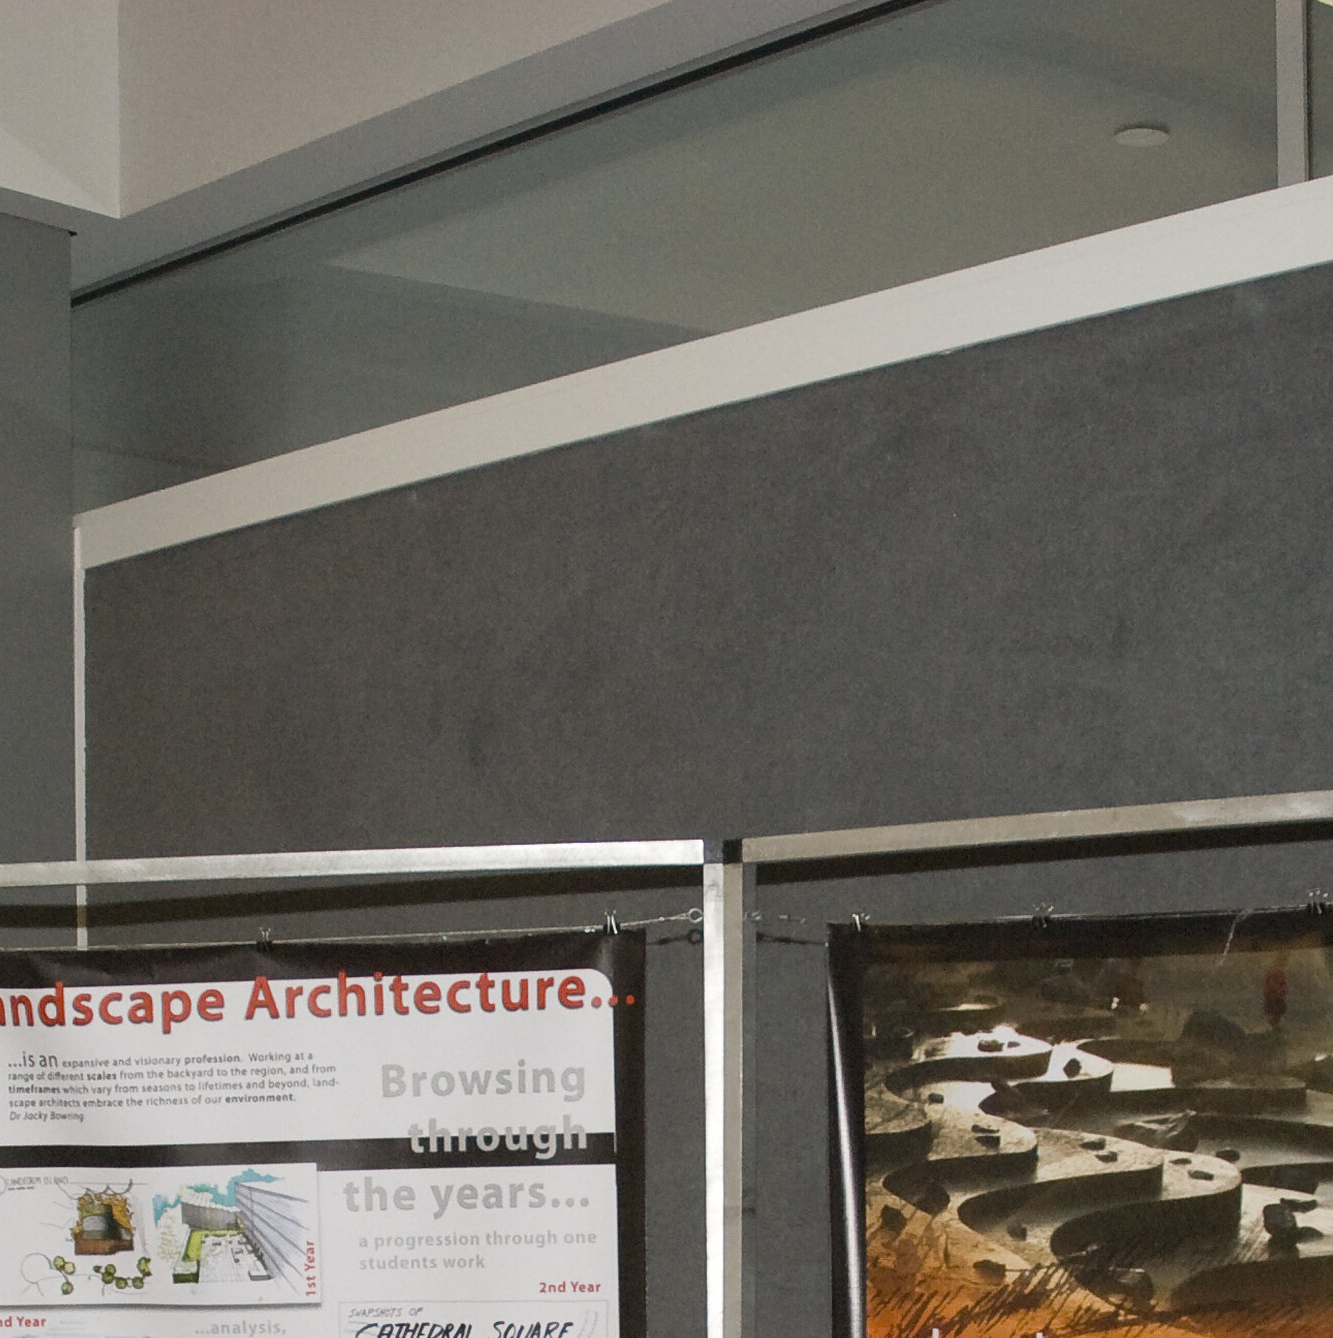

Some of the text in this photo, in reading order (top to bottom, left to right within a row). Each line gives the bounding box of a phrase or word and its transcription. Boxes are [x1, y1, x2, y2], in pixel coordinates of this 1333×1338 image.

[245, 971, 634, 1022] Architecture...
[39, 1052, 291, 1068] an expansive and visionary profession. Working
[87, 1064, 336, 1080] scales from the backyard the region, and from
[8, 1079, 309, 1096] timeframes which vary from seasons lifetimes and beyond,
[381, 1059, 585, 1102] Browsing
[9, 1093, 296, 1109] scape architects embrace the richness environment.
[408, 1115, 587, 1160] through
[343, 1177, 589, 1219] the years...
[374, 1230, 596, 1250] progression through one
[305, 1241, 316, 1296] 1st Year
[360, 1255, 485, 1270] students work
[540, 1281, 601, 1293] 2nd Year
[349, 1308, 402, 1317] SNAPSHOTS
[17, 1317, 47, 1327] Year
[195, 1321, 286, 1337] ...analysis,
